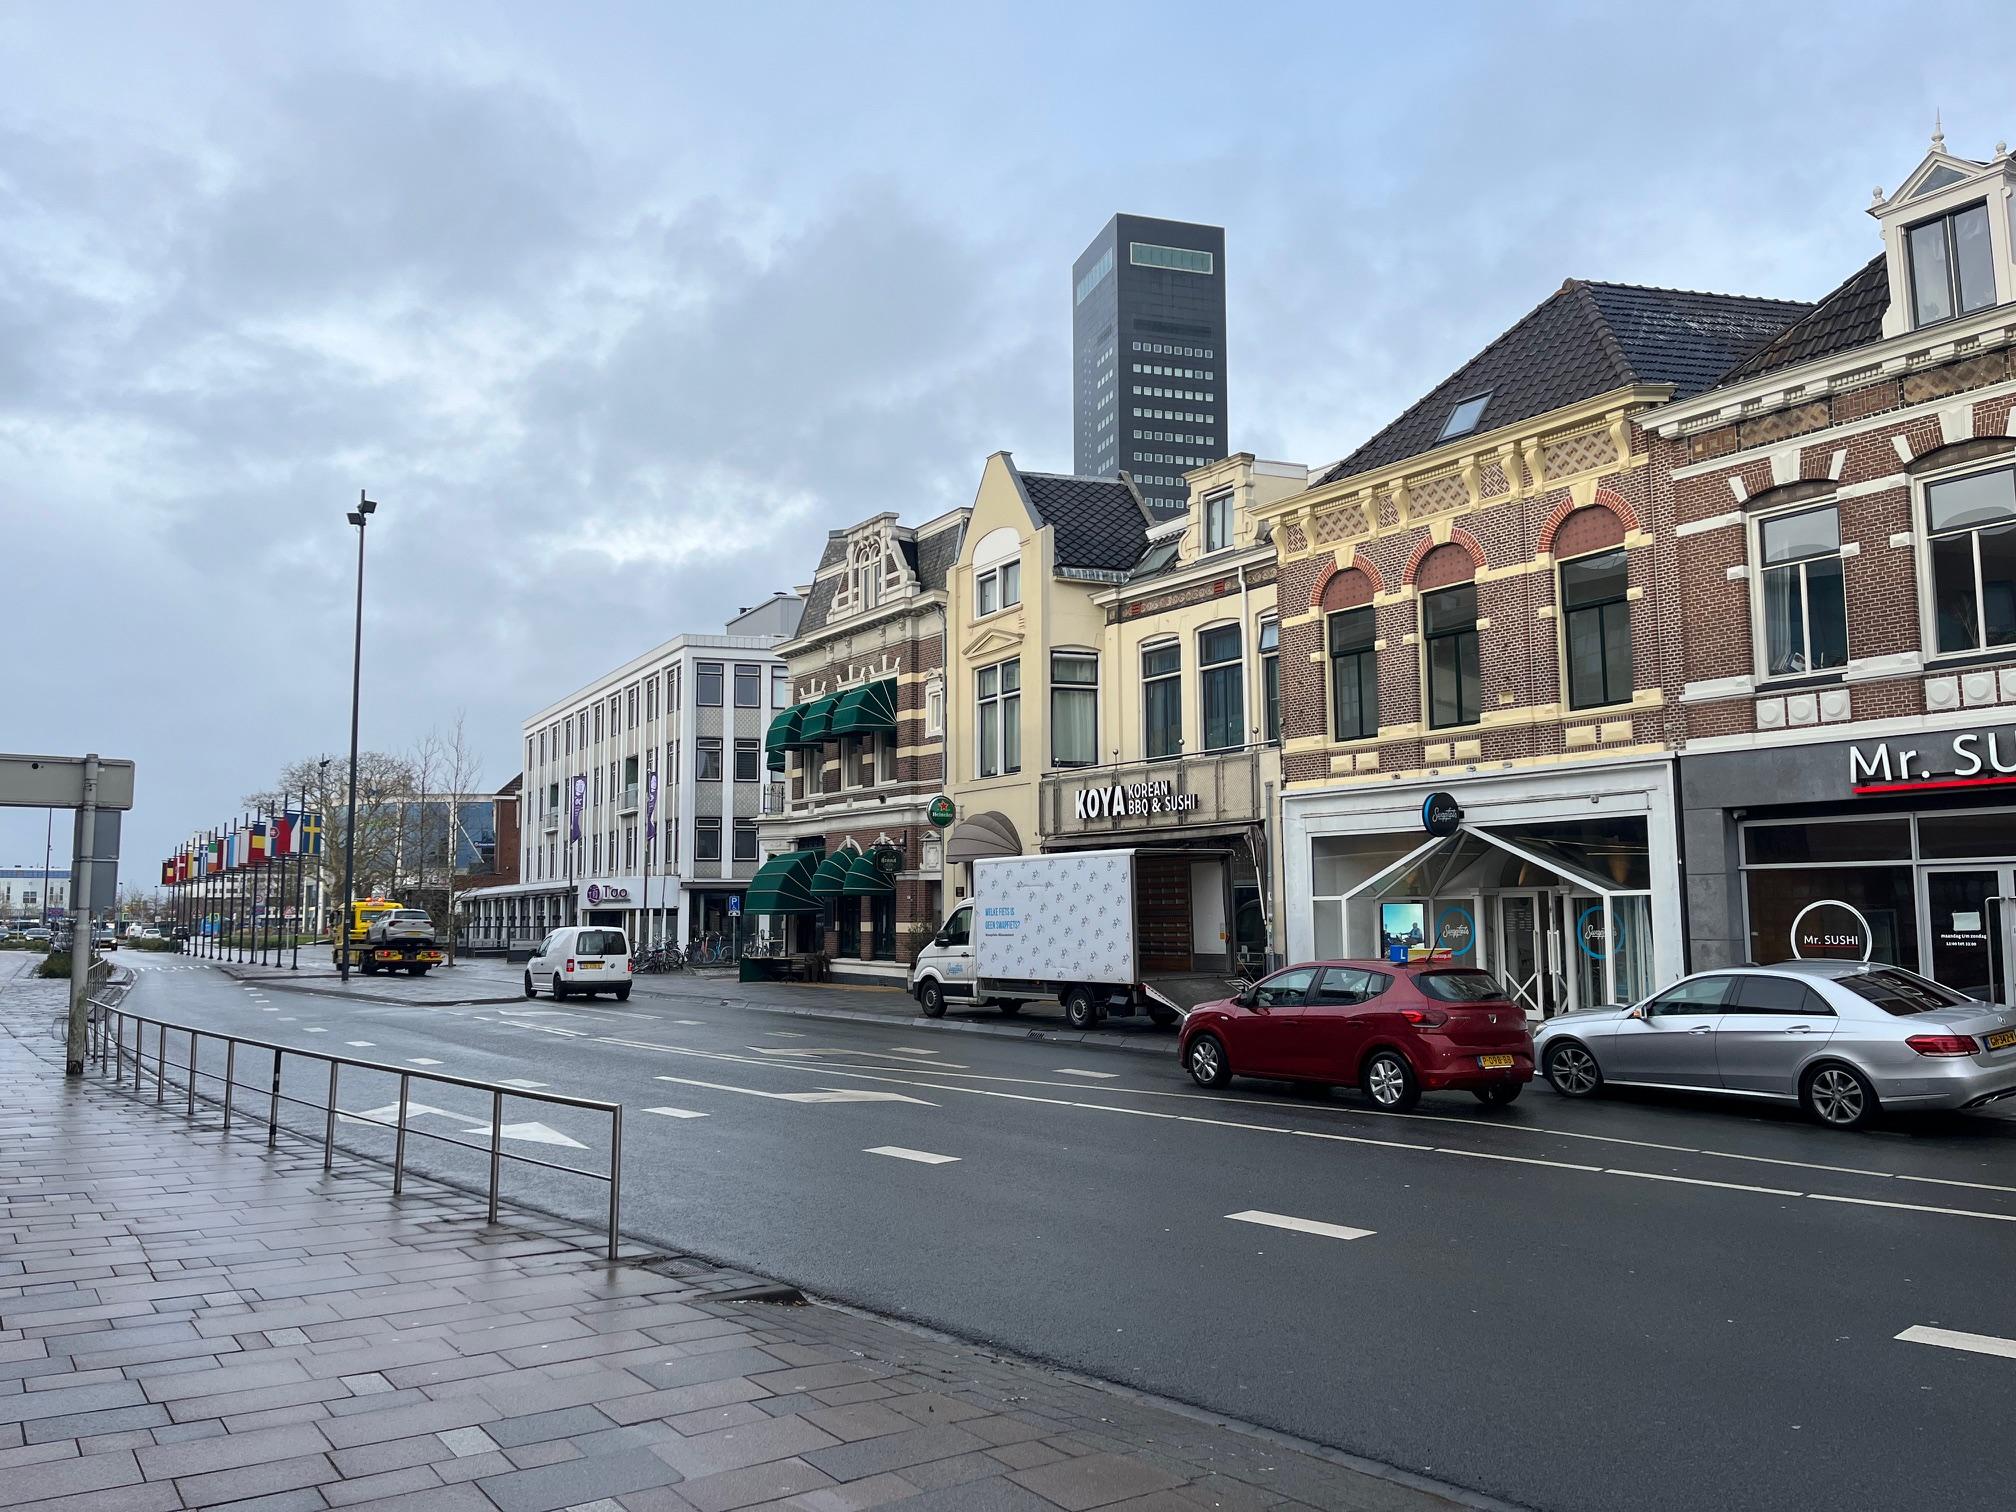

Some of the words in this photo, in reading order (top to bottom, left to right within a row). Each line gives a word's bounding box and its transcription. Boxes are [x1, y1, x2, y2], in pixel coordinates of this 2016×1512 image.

[1850, 743, 1931, 784] Mr.
[1953, 731, 2016, 776] SU
[1075, 785, 1126, 819] KOYA
[1128, 780, 1169, 800] KOREAN
[1128, 797, 1149, 816] BBQ
[1151, 797, 1162, 812] &
[1165, 793, 1196, 812] SUSHI
[603, 885, 628, 898] Tao
[1804, 935, 1821, 945] Mr.
[1825, 935, 1859, 945] SUSHI
[1400, 948, 1406, 960] L
